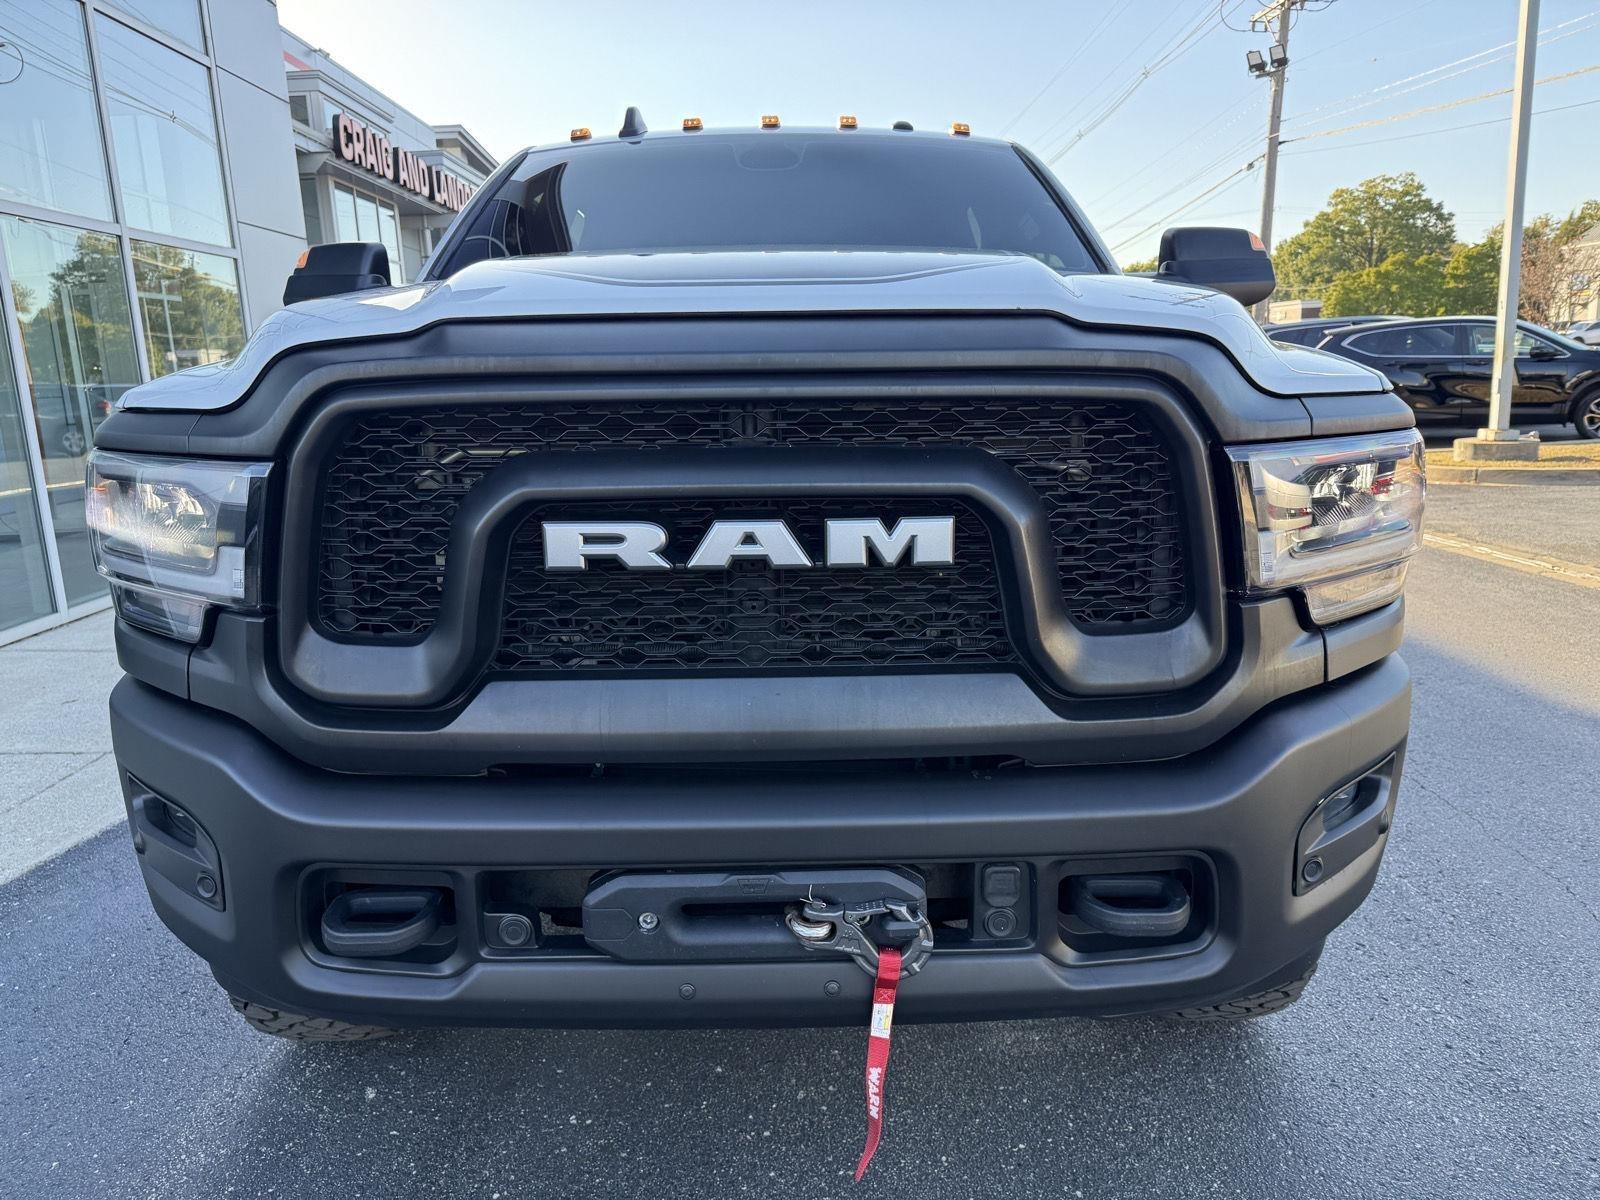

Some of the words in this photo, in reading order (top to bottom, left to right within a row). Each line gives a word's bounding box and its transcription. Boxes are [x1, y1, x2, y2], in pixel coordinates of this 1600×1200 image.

[335, 112, 394, 180] CRAIG
[397, 148, 430, 197] AND
[541, 516, 956, 571] RAM
[868, 1066, 882, 1120] WARN
